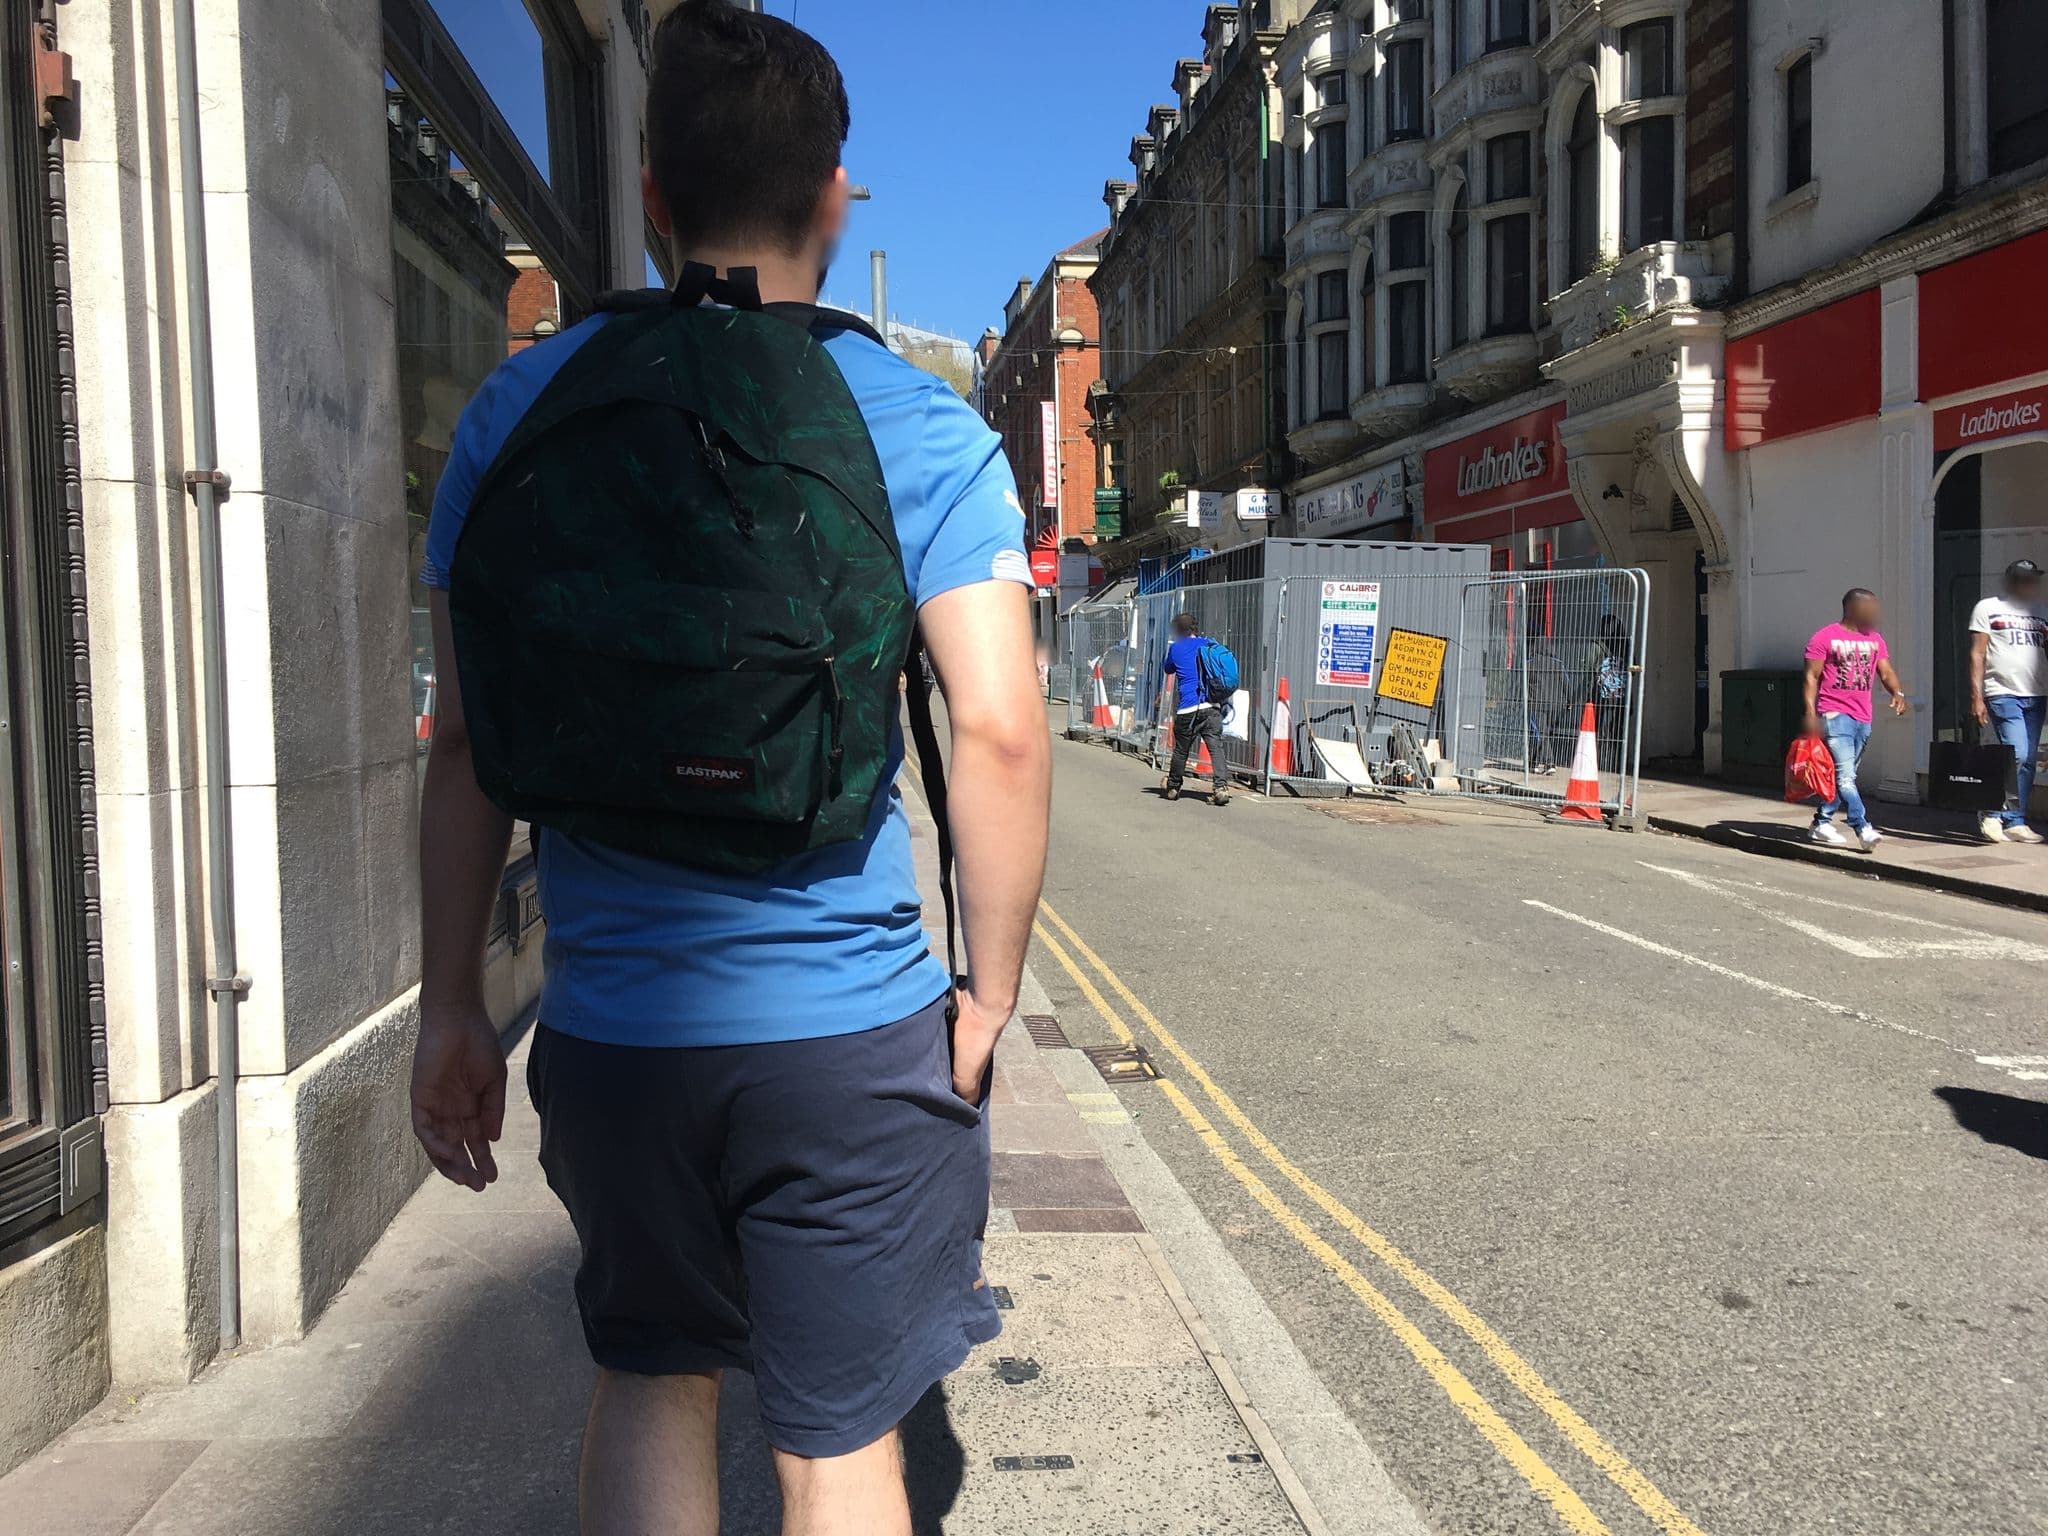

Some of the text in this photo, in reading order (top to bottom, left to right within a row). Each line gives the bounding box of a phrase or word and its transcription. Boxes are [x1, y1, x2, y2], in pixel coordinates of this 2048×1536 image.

[1960, 401, 2042, 437] Ladbrokes
[1457, 436, 1545, 497] Ladbrokes
[1251, 495, 1269, 503] G M
[1248, 505, 1273, 514] MUSIC
[1394, 643, 1414, 652] AGOR
[1407, 635, 1431, 648] MUSIC
[1405, 666, 1434, 680] MUSIC
[1389, 674, 1428, 691] OPEN AS
[1391, 686, 1420, 700] USUAL
[676, 766, 741, 779] EASTPAK
